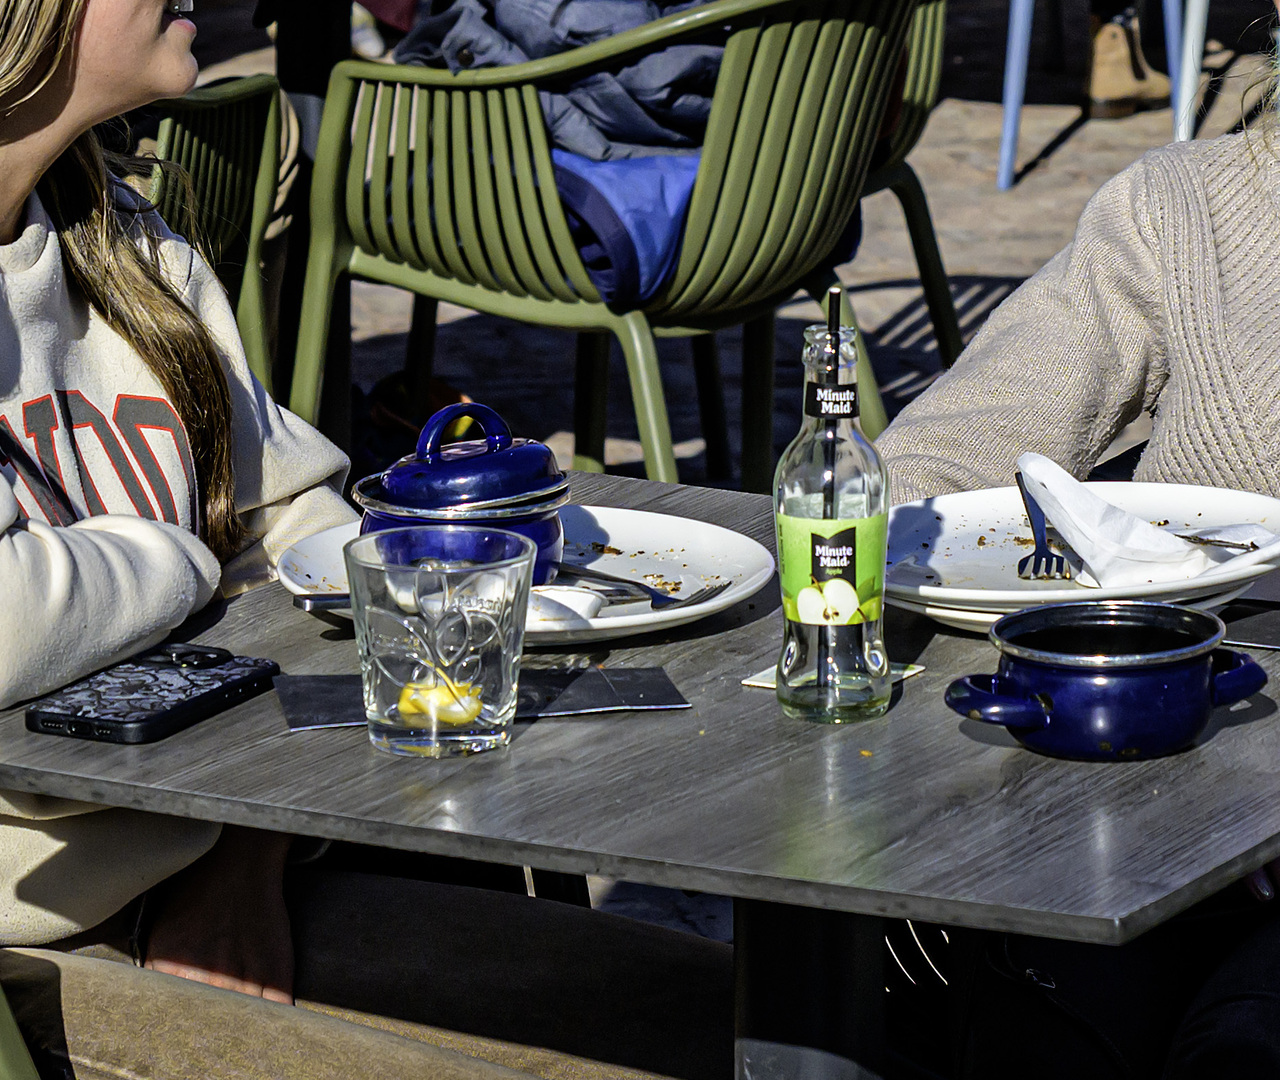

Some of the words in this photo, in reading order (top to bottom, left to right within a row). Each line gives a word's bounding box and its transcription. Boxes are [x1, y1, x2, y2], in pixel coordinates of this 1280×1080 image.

[816, 388, 855, 401] Minute
[821, 402, 851, 414] Maid
[815, 545, 853, 557] Minute
[820, 556, 848, 567] Maid
